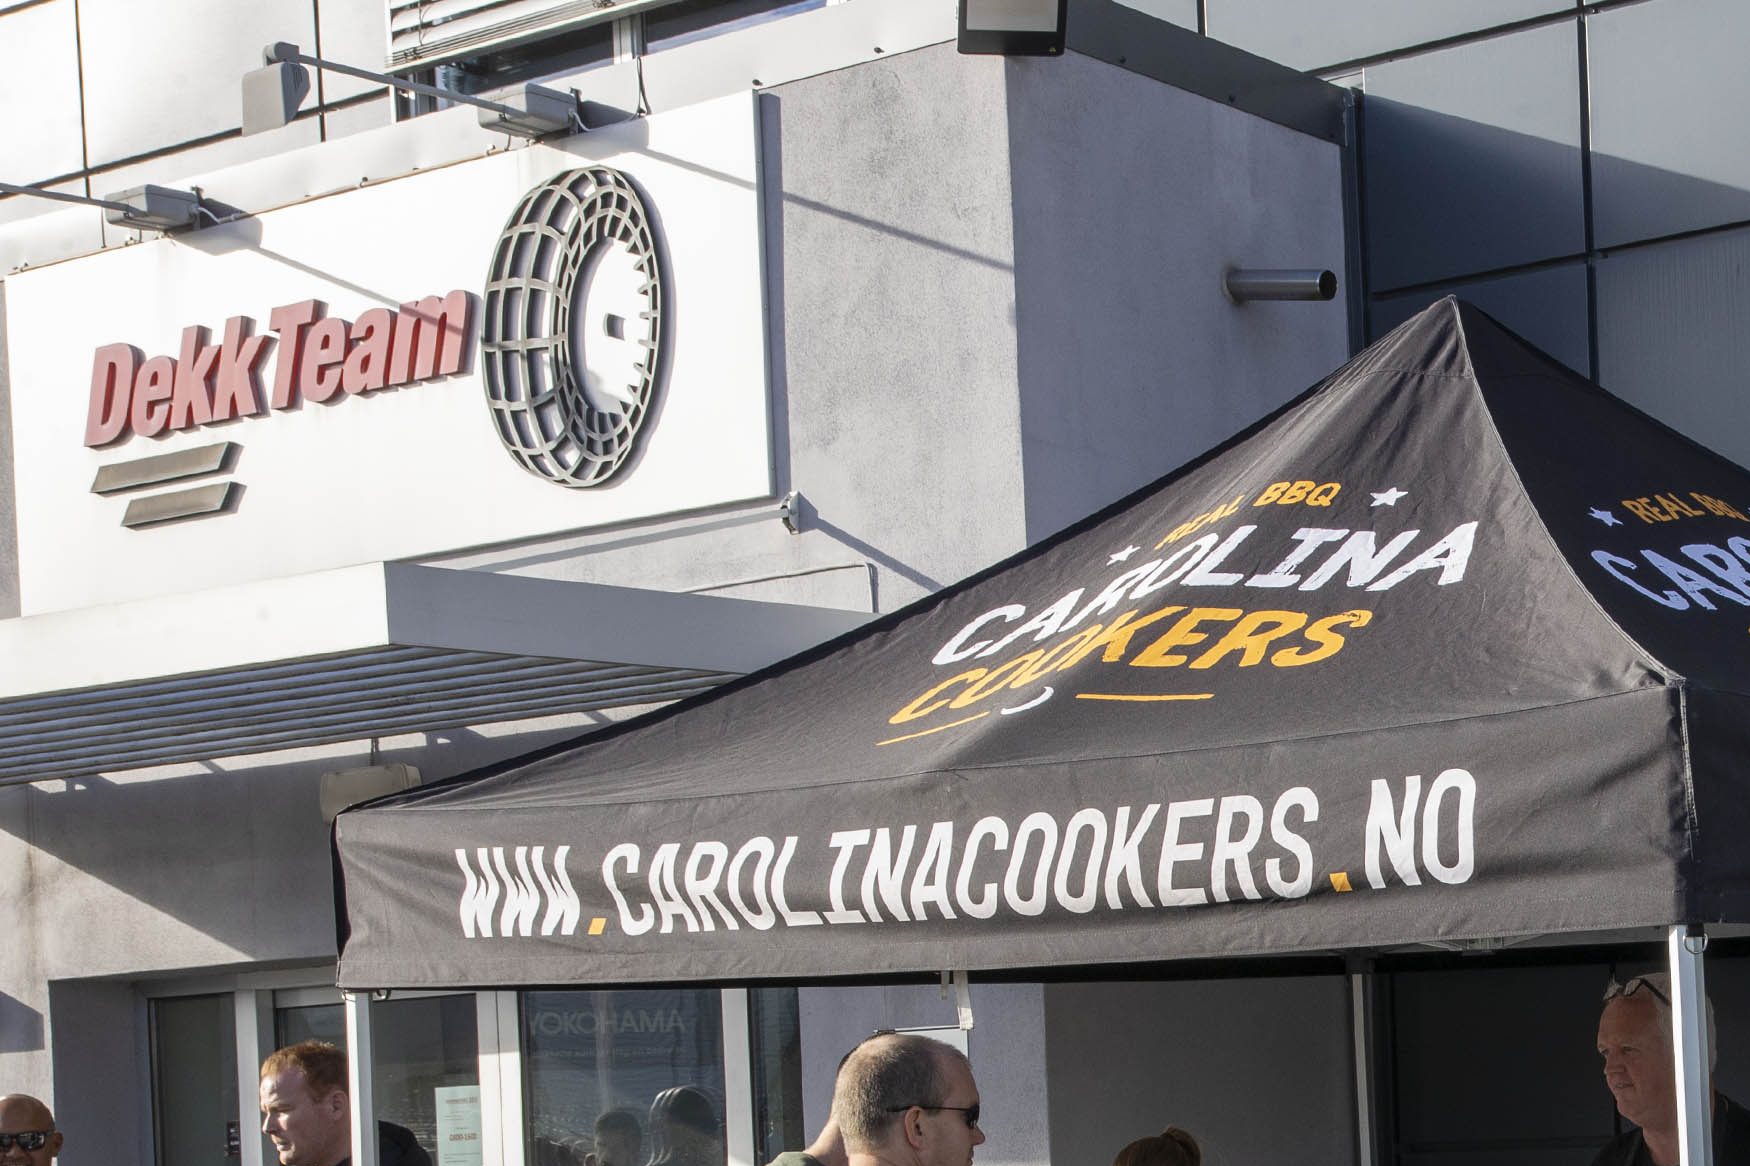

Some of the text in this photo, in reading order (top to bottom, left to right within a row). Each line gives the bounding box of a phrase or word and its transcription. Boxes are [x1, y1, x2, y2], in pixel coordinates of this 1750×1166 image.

[84, 289, 475, 448] DekkTeam
[1154, 480, 1342, 551] REAL BBQ
[1621, 492, 1705, 525] REAL
[931, 520, 1479, 666] CAROLINA
[887, 605, 1374, 725] COOKERS
[455, 768, 1477, 939] WWW.CAROLINACOOKERS.NO
[530, 1009, 687, 1036] YOKOHAMA
